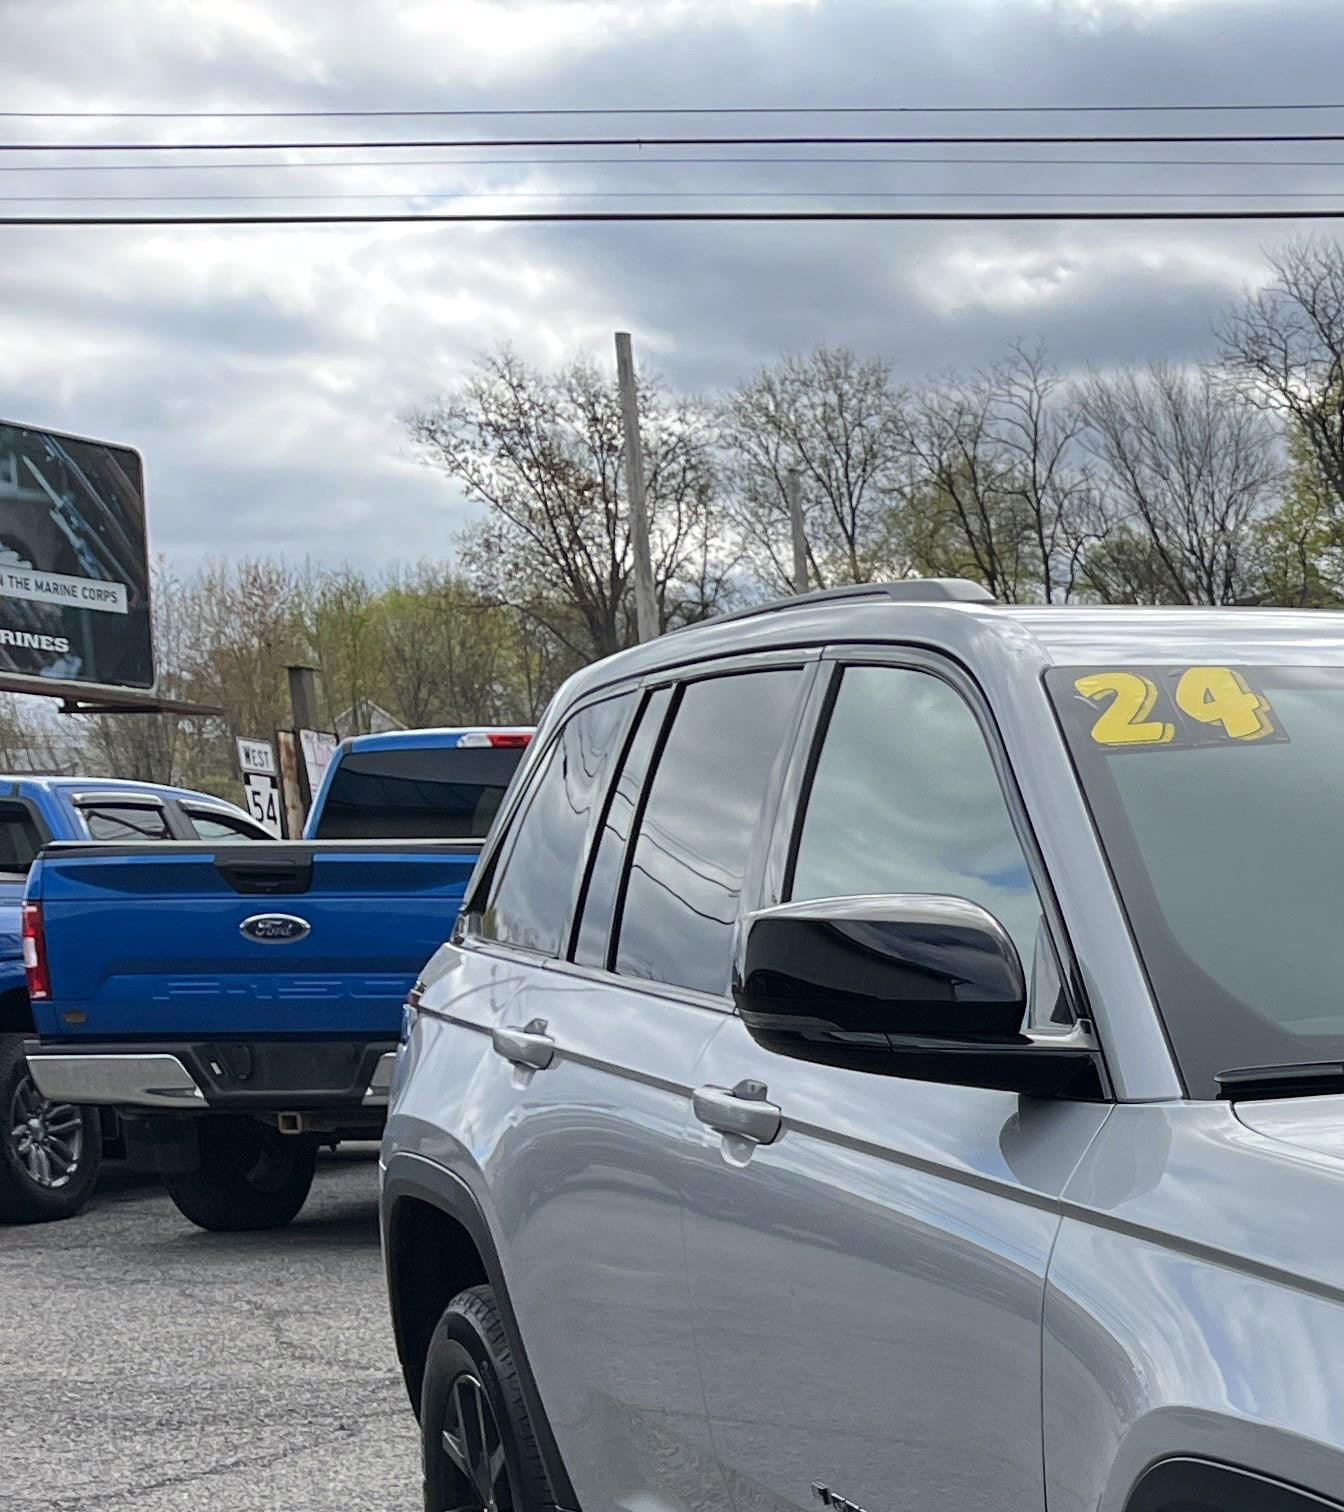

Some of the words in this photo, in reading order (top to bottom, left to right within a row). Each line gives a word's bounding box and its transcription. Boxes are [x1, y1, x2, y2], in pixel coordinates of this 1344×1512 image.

[7, 575, 31, 591] THE
[35, 579, 78, 598] MARINE
[81, 586, 118, 604] CORPS
[1074, 667, 1274, 746] 24
[242, 745, 269, 769] WEST
[251, 790, 278, 825] 54
